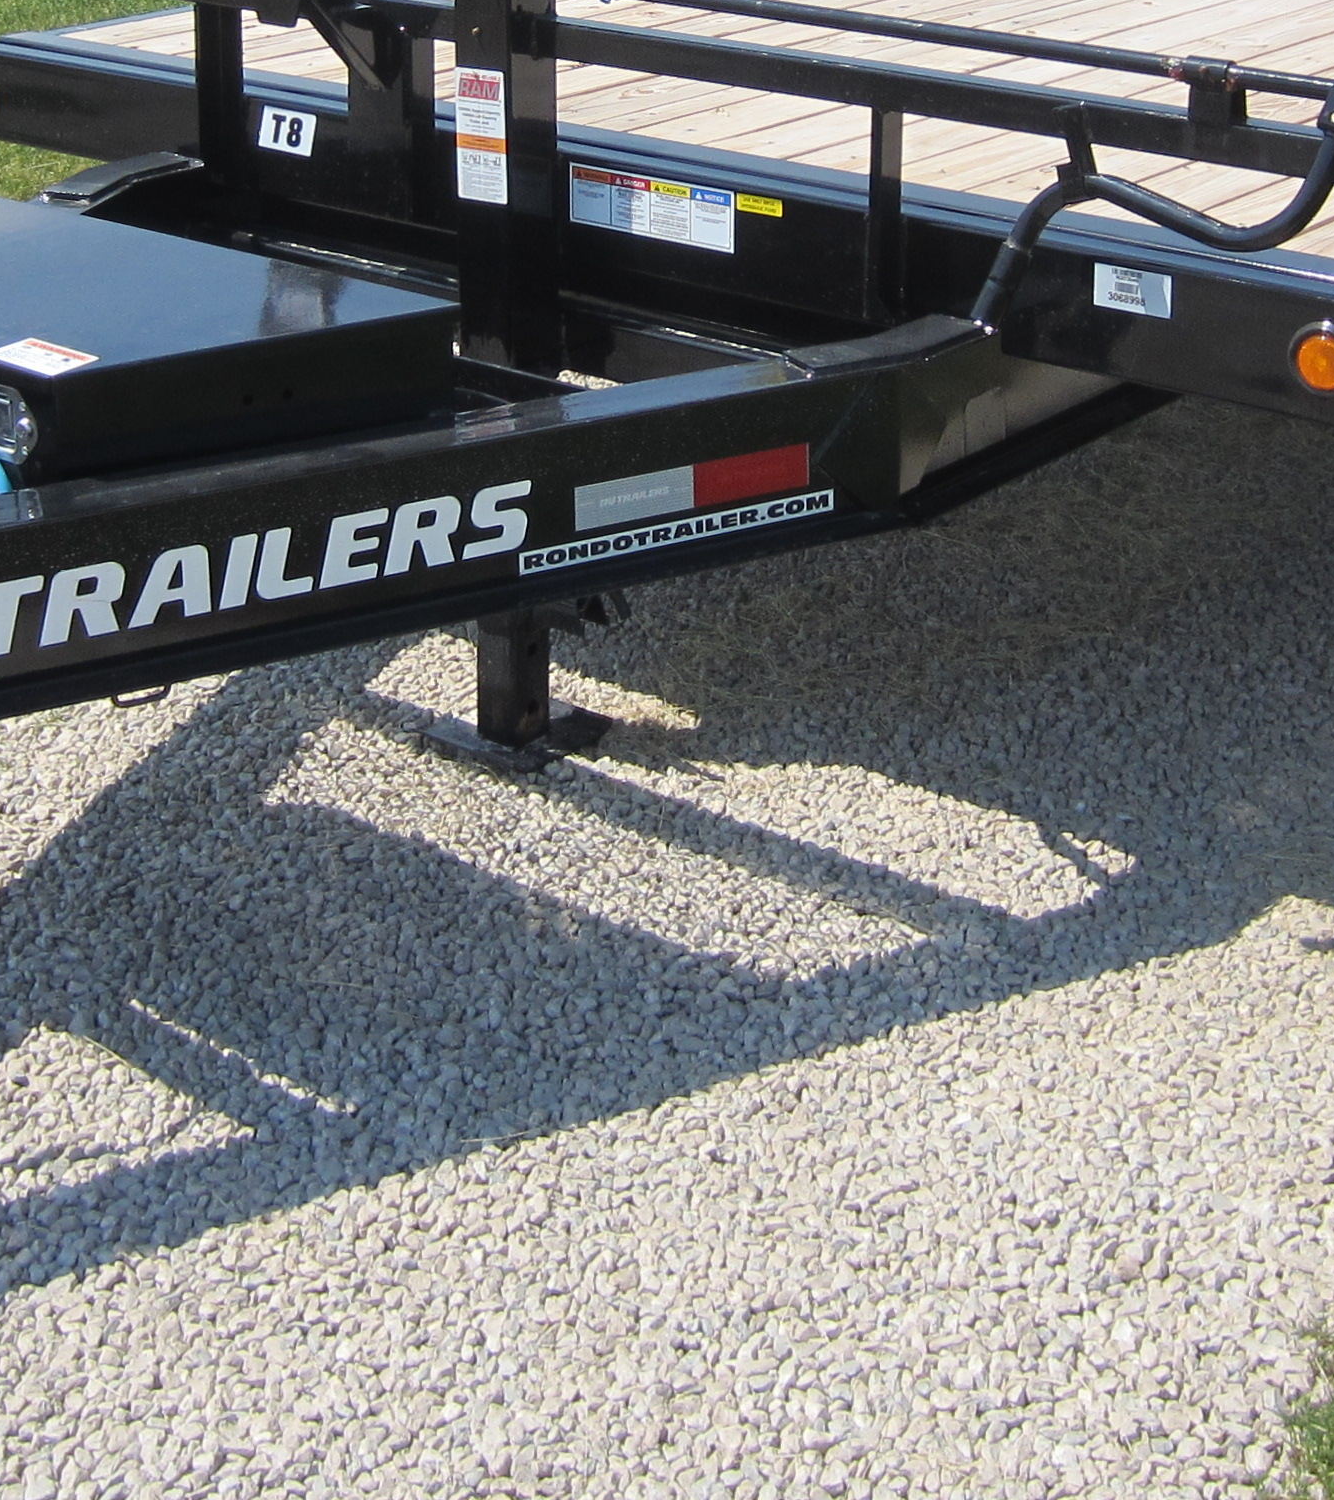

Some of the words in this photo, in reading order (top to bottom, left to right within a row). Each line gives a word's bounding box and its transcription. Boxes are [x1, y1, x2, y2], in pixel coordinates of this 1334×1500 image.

[460, 79, 500, 100] RAM
[271, 113, 303, 148] T8
[622, 177, 646, 189] DANGER
[523, 494, 830, 570] RONDOTRAILER.COM
